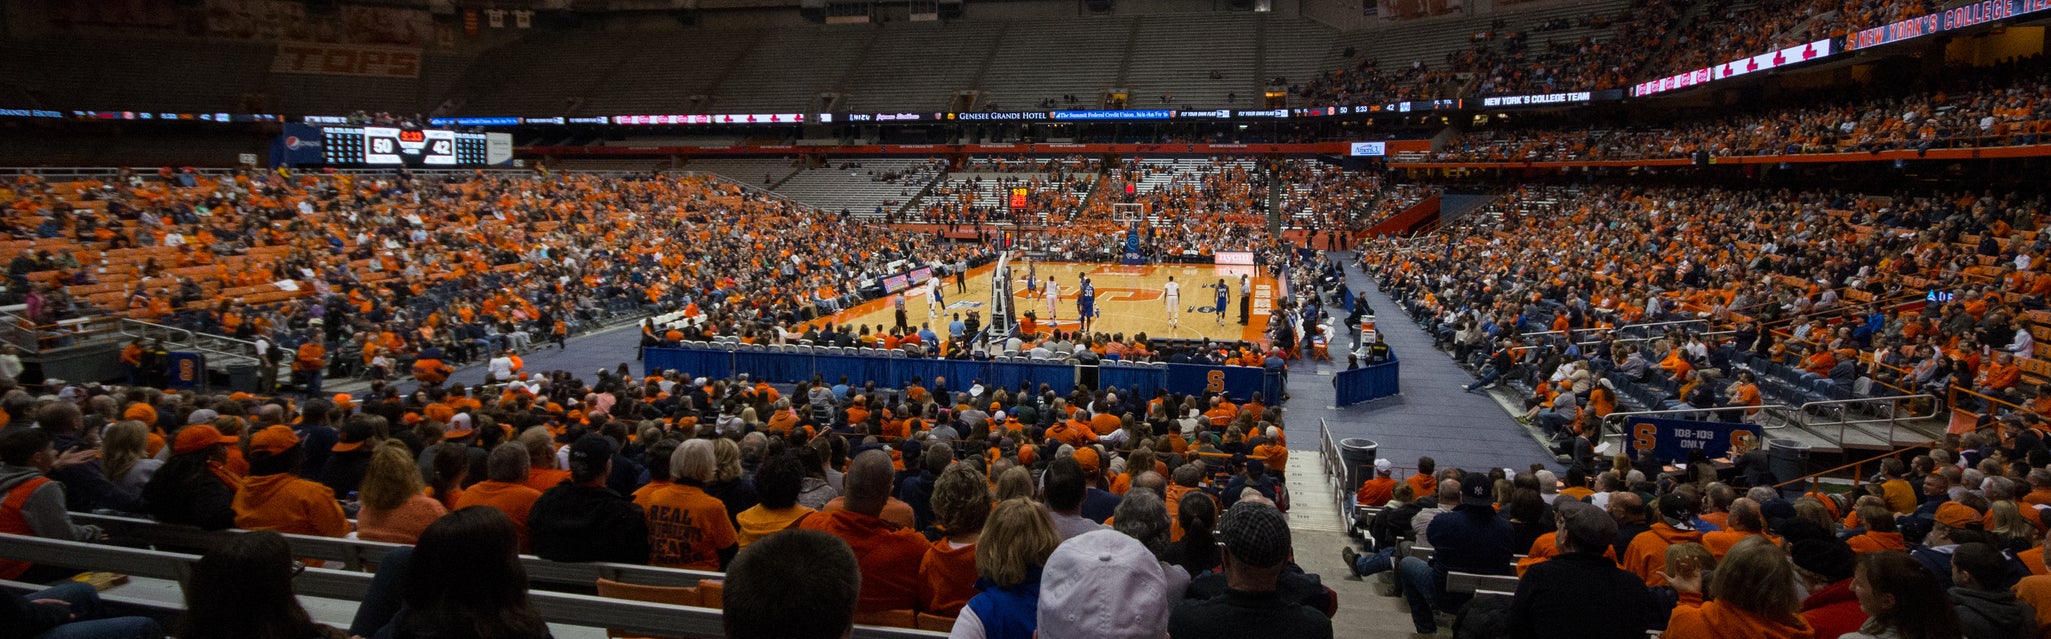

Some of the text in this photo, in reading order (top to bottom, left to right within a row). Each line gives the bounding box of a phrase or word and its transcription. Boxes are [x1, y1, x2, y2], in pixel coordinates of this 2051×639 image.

[1859, 26, 1884, 48] NEW
[1889, 13, 1937, 42] YORK'S
[1943, 0, 2013, 31] COLLEGE
[282, 46, 417, 76] TOPS
[1484, 92, 1591, 106] NEW YORK'S COLLEGE TEAM
[959, 112, 989, 120] GENESEE
[990, 112, 1021, 120] GRANDE
[1340, 106, 1348, 114] 50
[1355, 105, 1368, 113] 5:33
[401, 131, 422, 141] 5:33
[373, 138, 393, 154] 50
[432, 140, 451, 155] 42
[1218, 252, 1252, 262] nycm
[1084, 289, 1093, 298] 30
[1207, 369, 1225, 393] S
[1633, 423, 1657, 450] S
[1674, 428, 1714, 440] 108-109
[1680, 440, 1706, 449] ONLY
[650, 504, 692, 525] REAL
